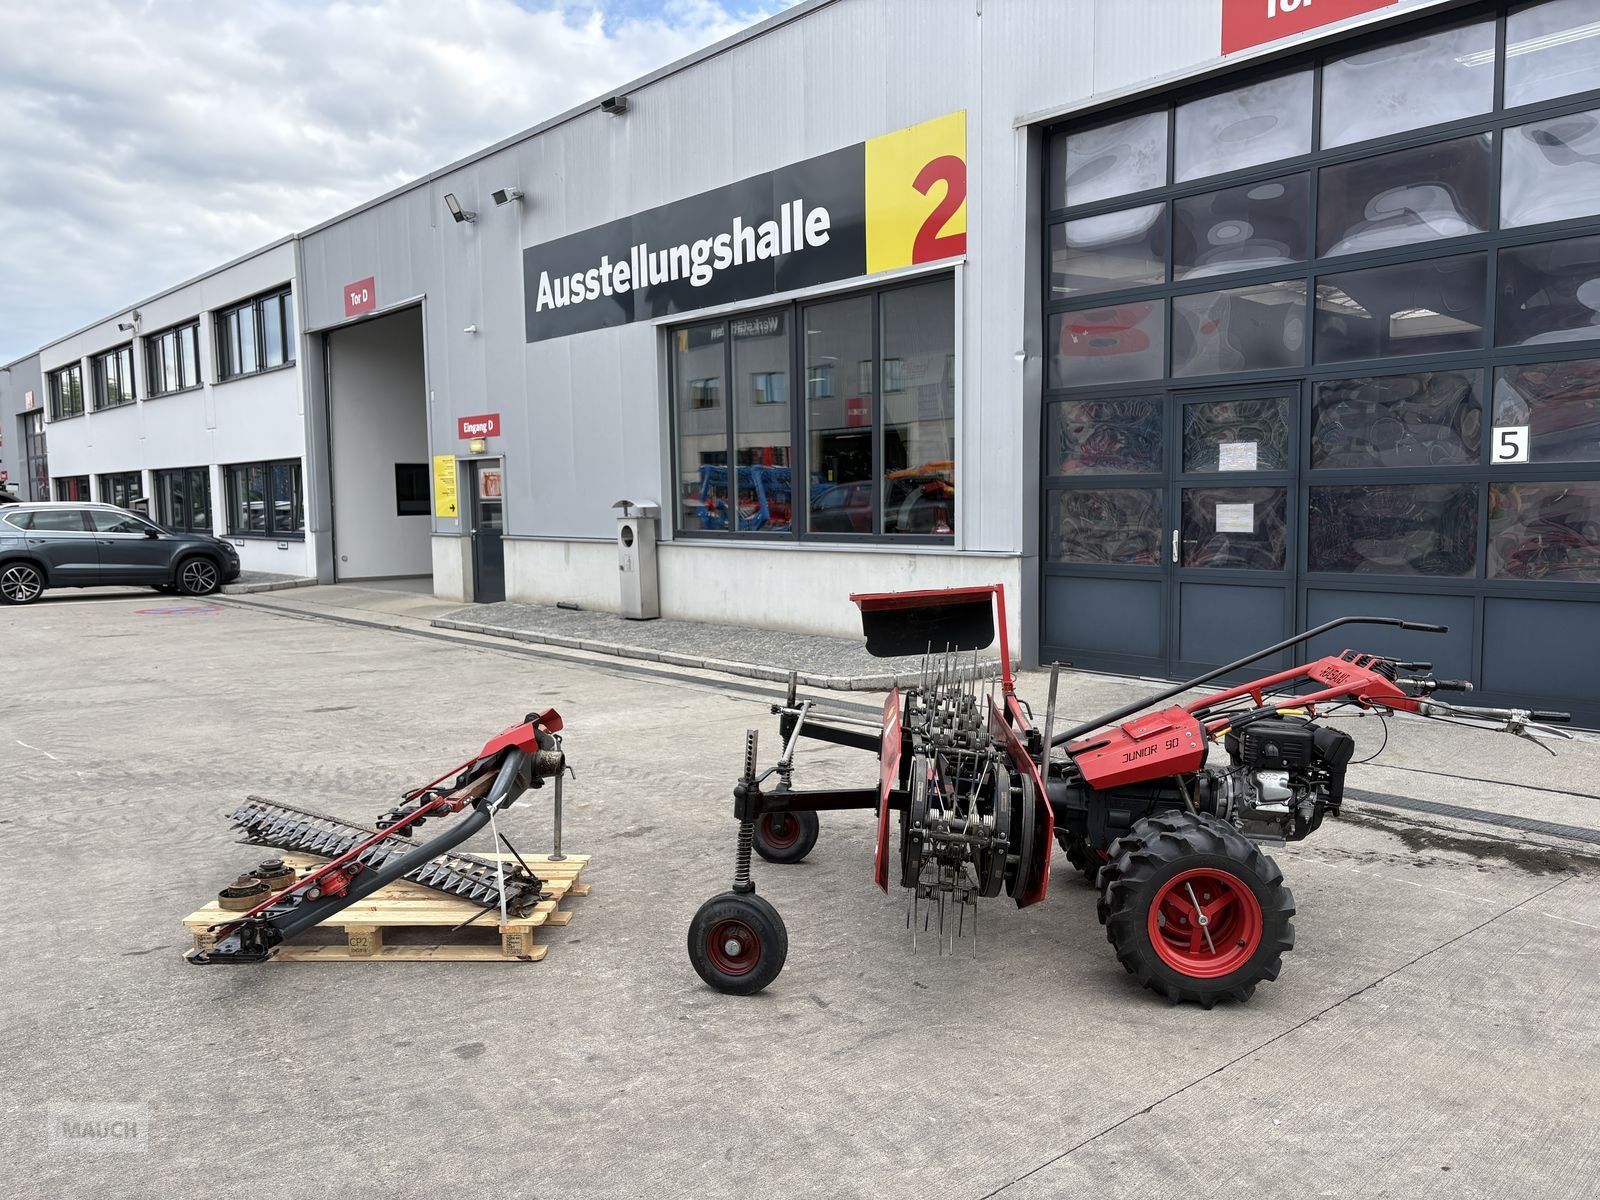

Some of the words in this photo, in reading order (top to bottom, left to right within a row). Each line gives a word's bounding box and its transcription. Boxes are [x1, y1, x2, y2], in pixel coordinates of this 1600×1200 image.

[536, 199, 831, 312] Ausstellungshalle
[912, 155, 967, 264] 2
[350, 292, 361, 306] Tor
[362, 289, 368, 303] D
[463, 422, 487, 434] Eingang
[488, 419, 494, 431] D
[1499, 431, 1519, 460] 5
[1122, 744, 1158, 763] JUNIOR
[1165, 737, 1179, 750] 90
